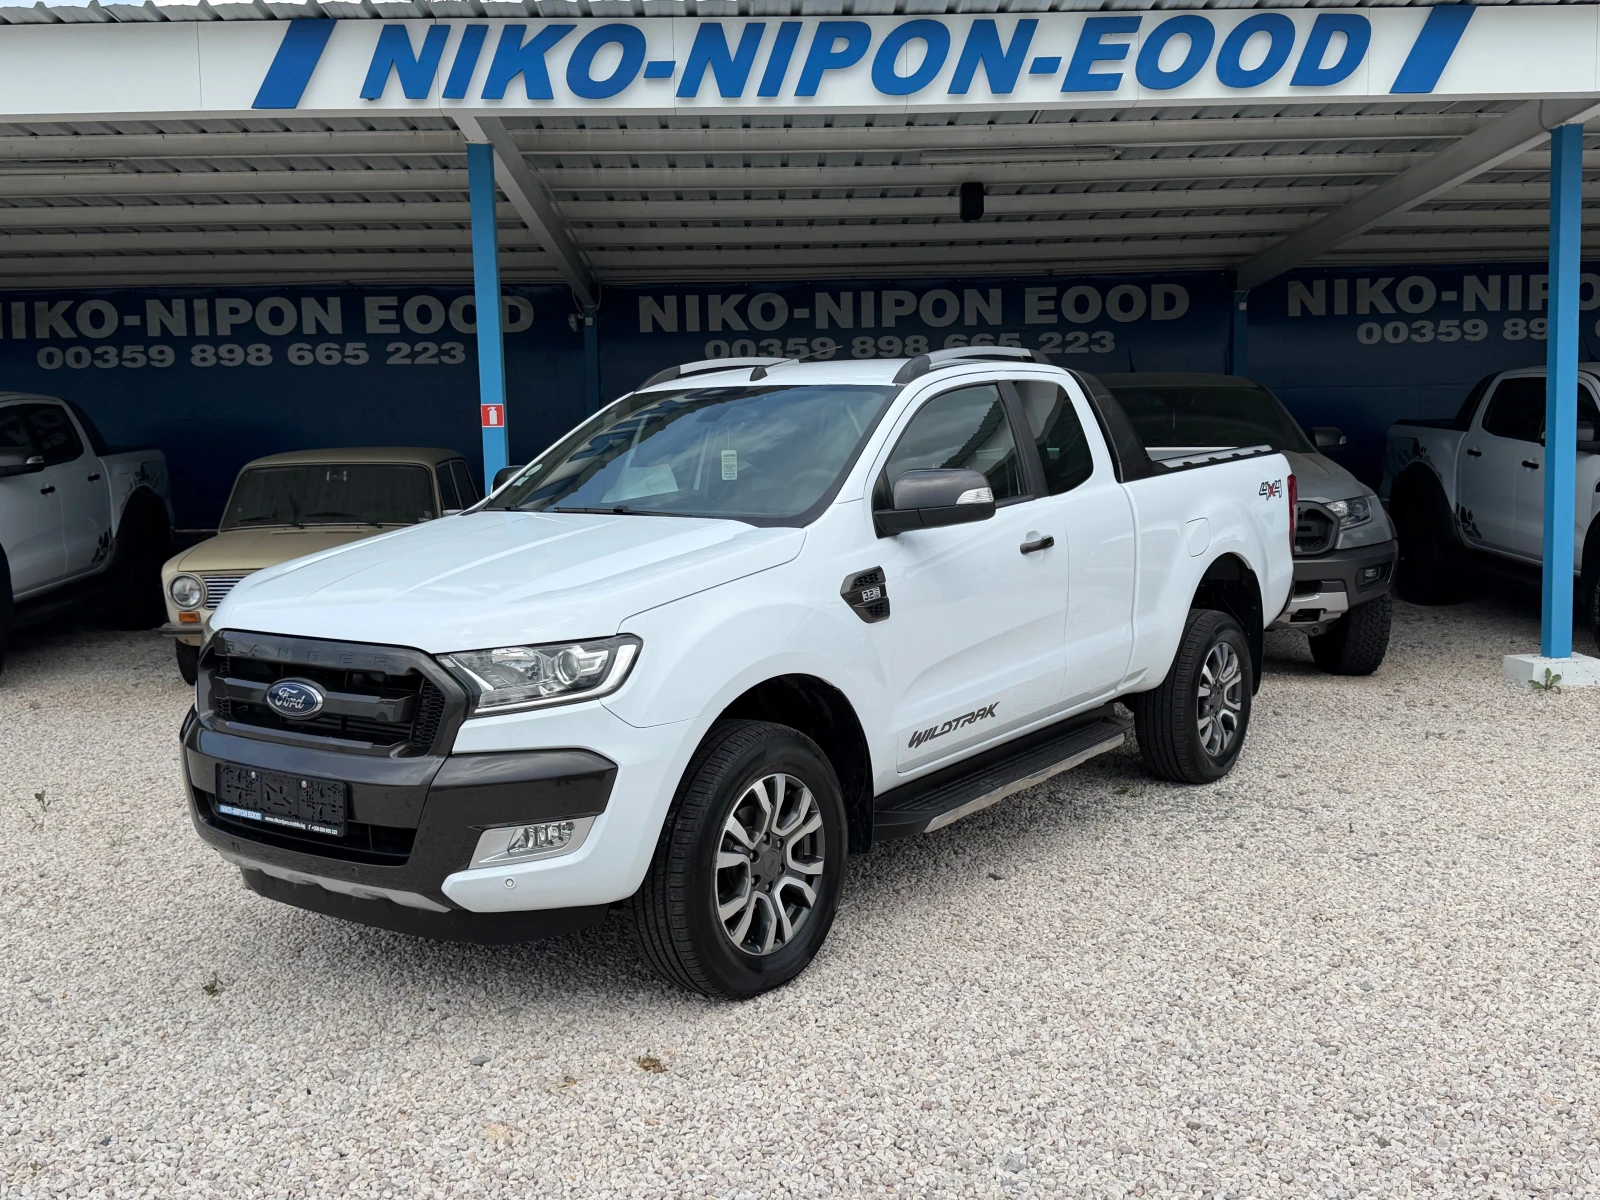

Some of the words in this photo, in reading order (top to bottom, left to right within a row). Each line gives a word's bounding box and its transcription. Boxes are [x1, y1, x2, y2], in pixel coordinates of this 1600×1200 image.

[360, 13, 1372, 100] NIKO-NIPON-EOOD
[0, 296, 343, 340] IKO-NIPON
[364, 294, 534, 335] EOOD
[639, 288, 1003, 333] NIKO-NIPON
[1024, 284, 1190, 324] EOOD
[704, 336, 837, 360] 00359
[851, 335, 930, 359] 898
[1038, 331, 1116, 354] 223
[1356, 318, 1489, 345] 00359
[1502, 317, 1548, 341] 89
[37, 344, 175, 370] 00359
[190, 343, 273, 367] 898
[287, 342, 370, 366] 665
[386, 341, 466, 365] 223
[226, 641, 389, 668] RANGER
[275, 686, 306, 710] Ford
[908, 701, 1000, 749] WILDTRAK
